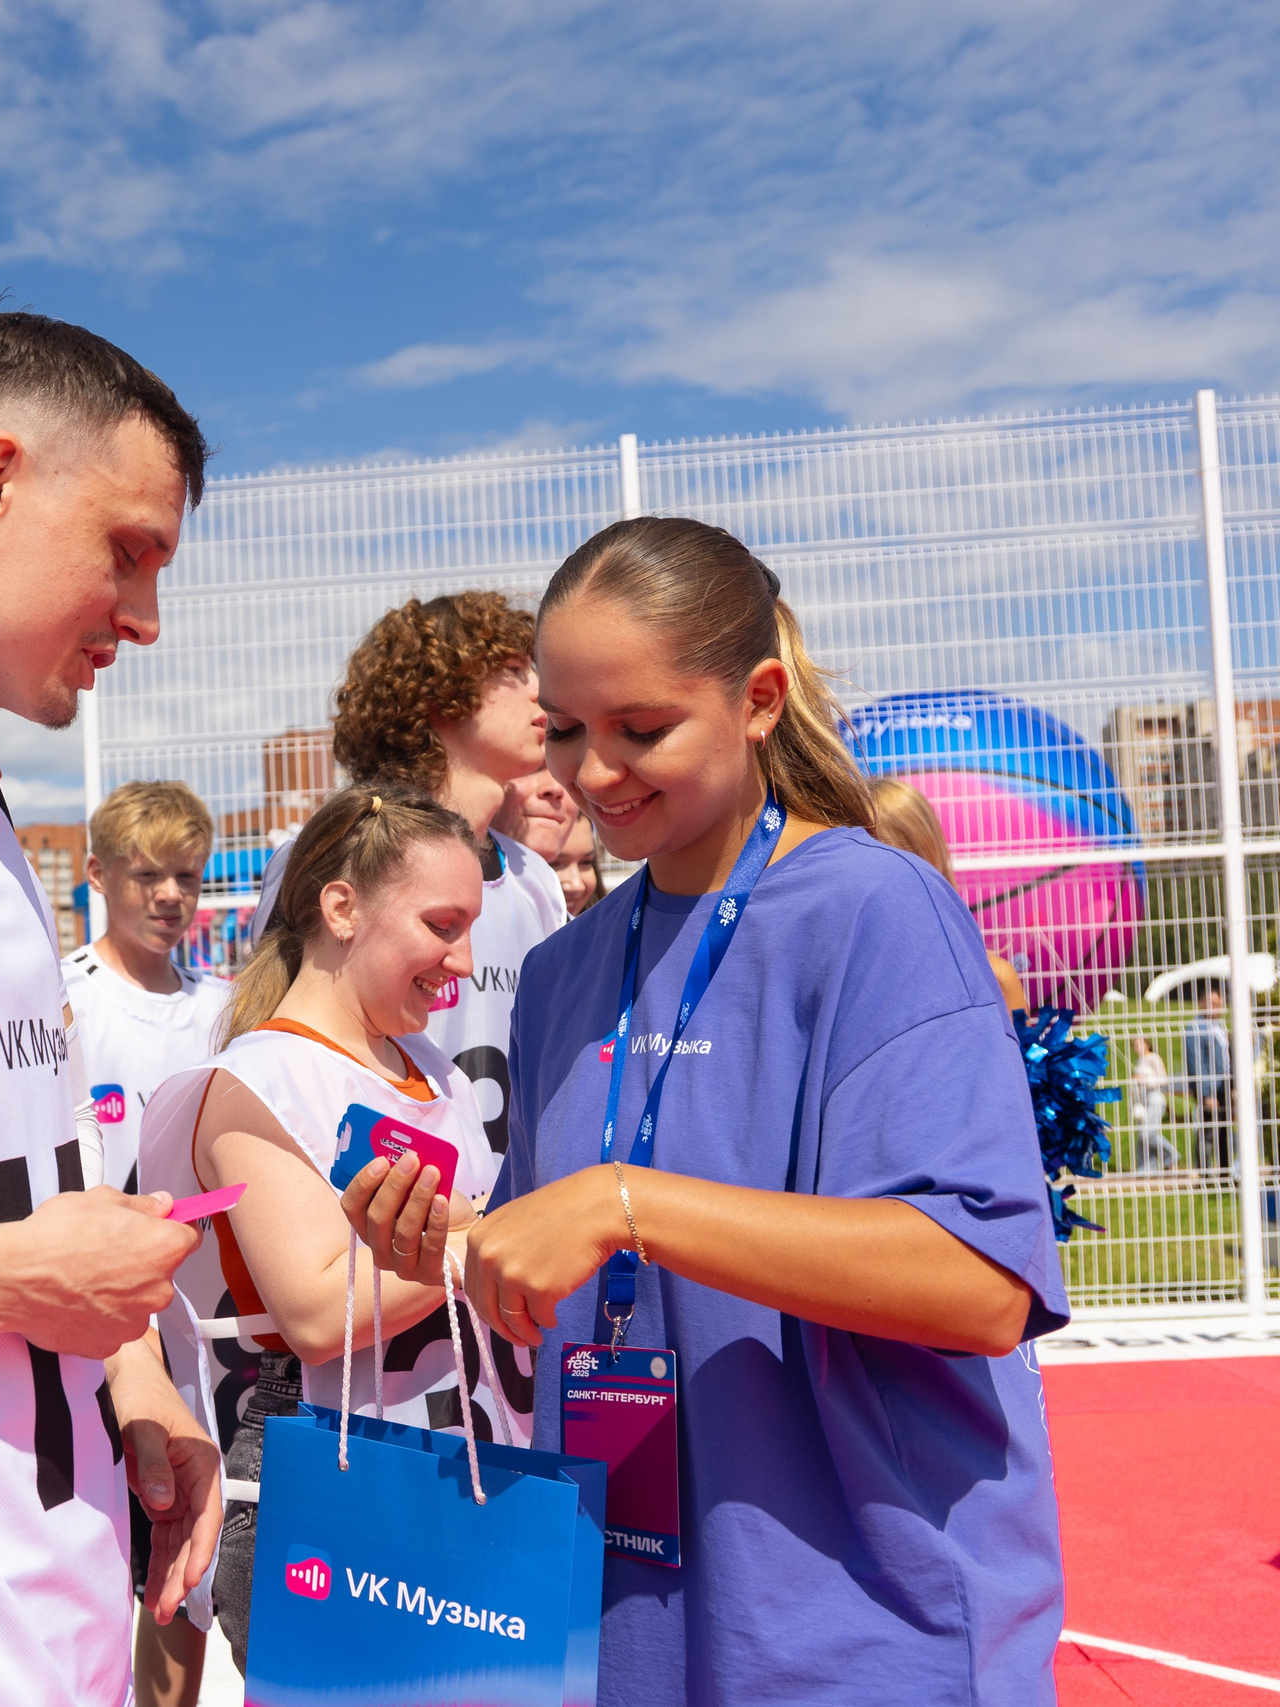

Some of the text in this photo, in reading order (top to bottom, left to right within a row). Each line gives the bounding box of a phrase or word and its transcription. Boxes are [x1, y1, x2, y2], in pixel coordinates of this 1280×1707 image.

[631, 1032, 712, 1057] VK Музыка
[566, 1356, 599, 1370] fest
[576, 1351, 592, 1360] VK
[571, 1369, 590, 1377] 2025
[567, 1389, 667, 1406] САНКТ-ПЕТЕРБУРГ
[345, 1567, 526, 1641] VK Музыка
